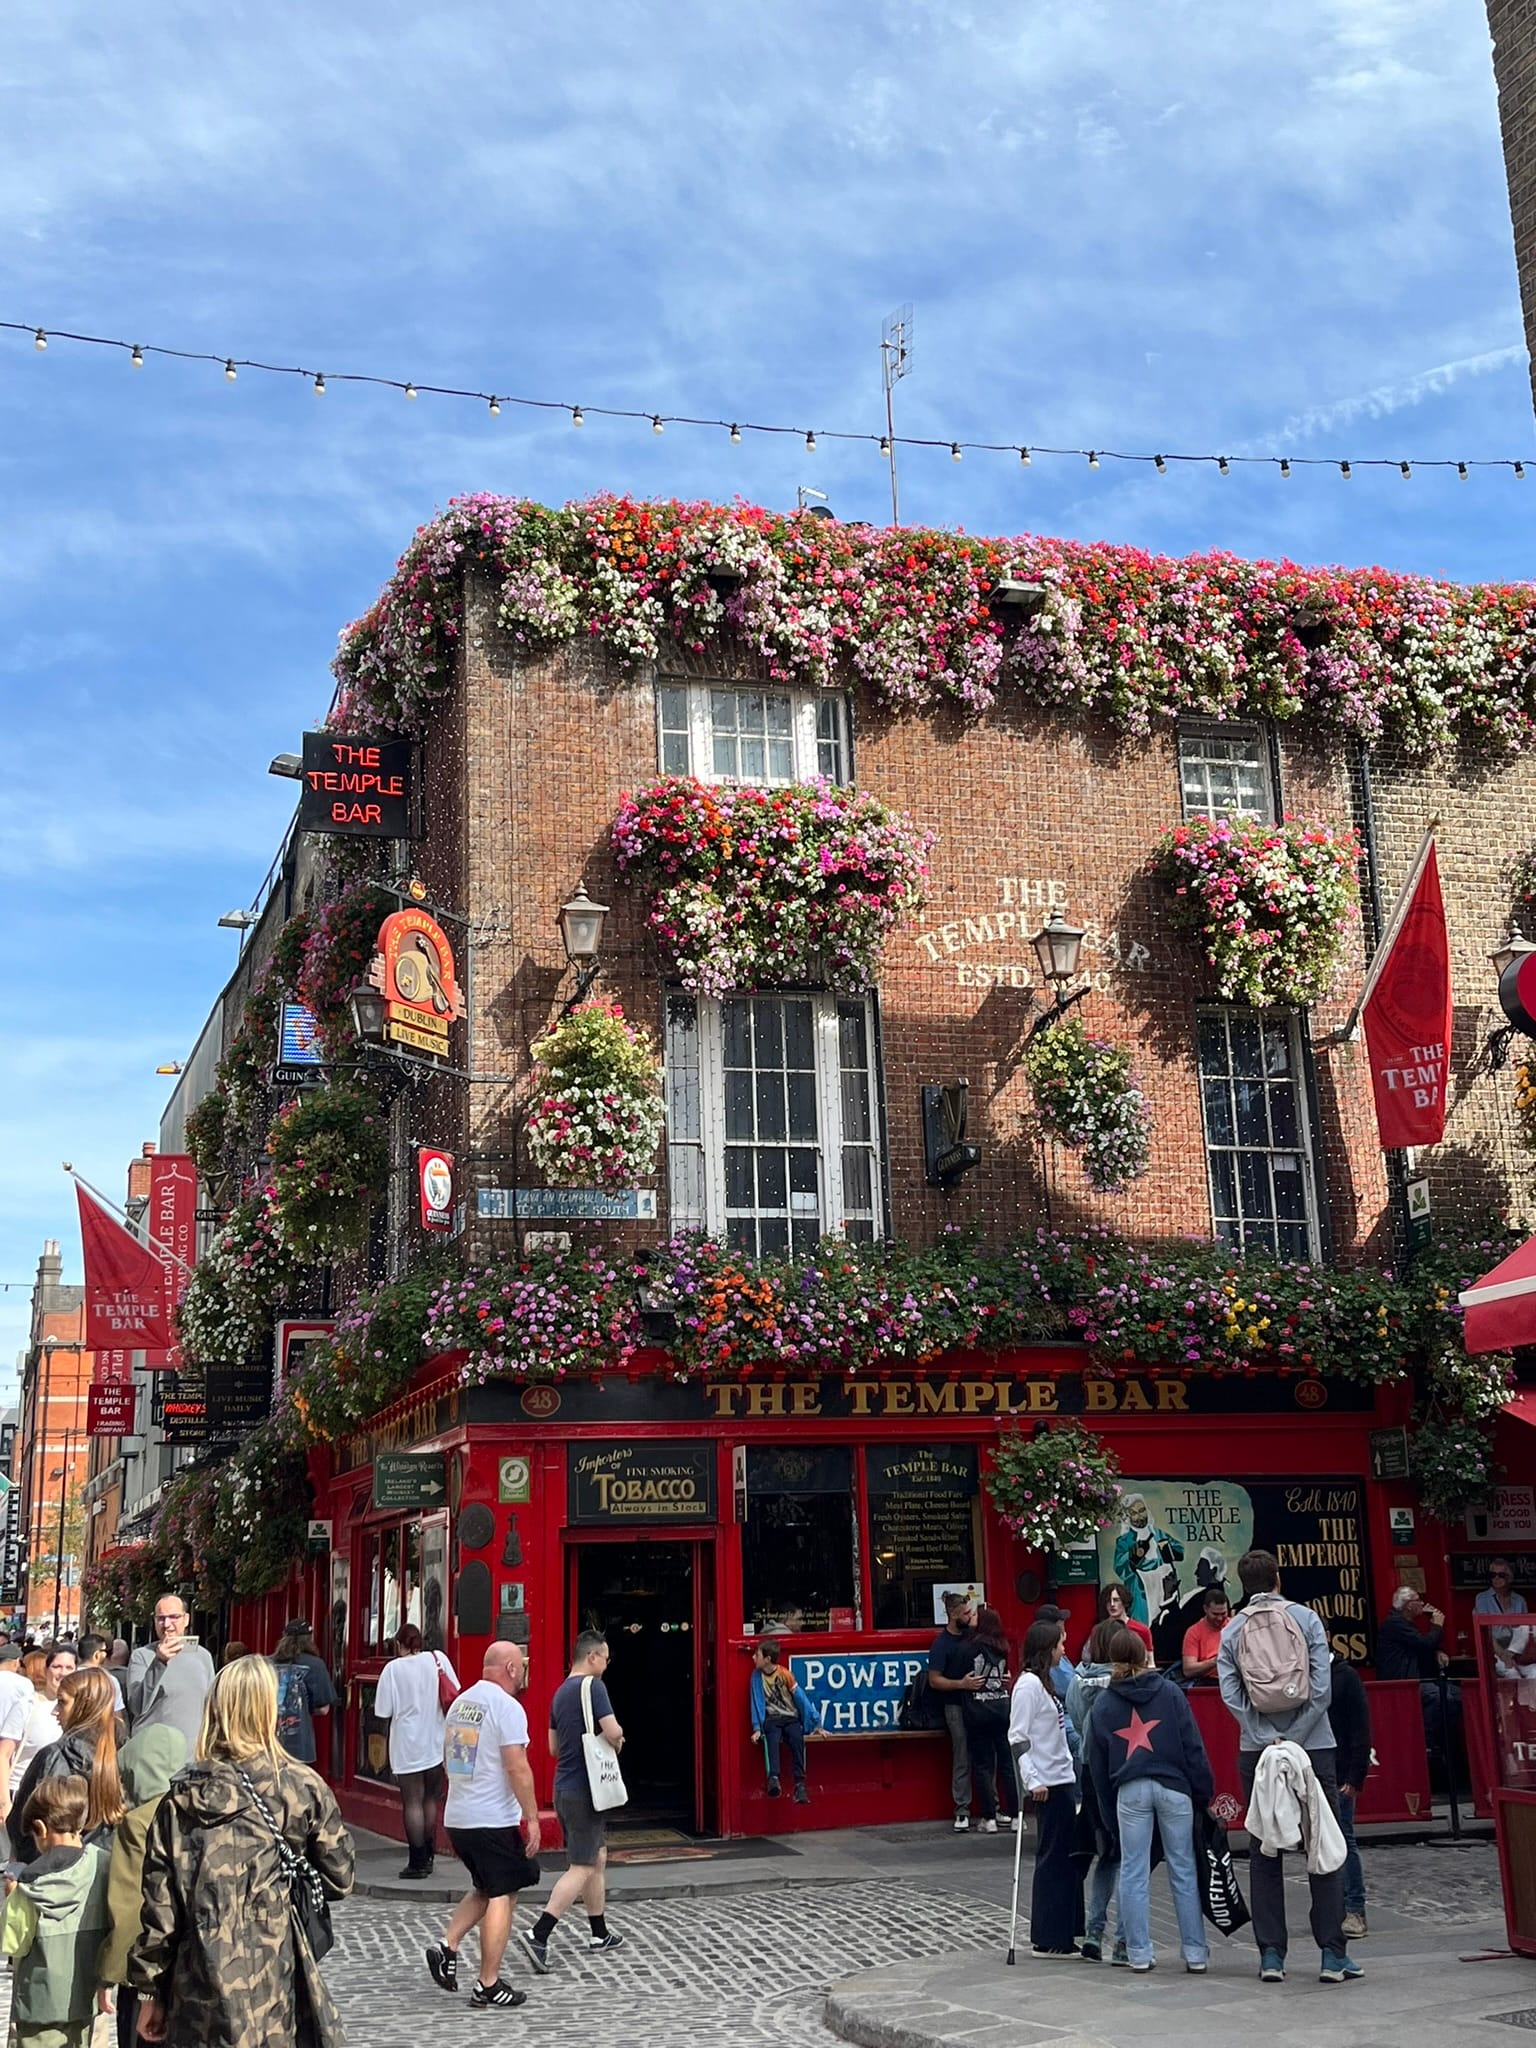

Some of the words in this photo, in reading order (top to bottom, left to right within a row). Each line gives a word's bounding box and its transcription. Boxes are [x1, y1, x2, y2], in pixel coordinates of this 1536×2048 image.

[332, 744, 381, 767] THE
[307, 771, 404, 796] TEMPLE
[332, 802, 382, 824] BAR
[996, 878, 1068, 907] THE
[399, 916, 441, 941] TEMPLE
[1082, 919, 1151, 972] BAR
[403, 1008, 438, 1028] DUBLIN
[396, 1027, 416, 1043] LIVE
[417, 1034, 444, 1051] MUSIC
[1409, 1043, 1444, 1062] THE
[161, 1184, 175, 1221] BAR
[592, 1204, 631, 1215] SOUTH
[178, 1222, 189, 1241] CO.
[112, 1293, 139, 1304] THE
[92, 1304, 160, 1318] TEMPLE
[111, 1317, 147, 1330] BAR
[93, 1397, 131, 1405] TEMPLE
[104, 1387, 122, 1396] THE
[179, 1392, 205, 1400] TEMPL
[528, 1390, 552, 1409] 48
[706, 1383, 822, 1415] THE
[844, 1381, 1058, 1415] TEMPLE
[1084, 1379, 1190, 1411] BAR
[1299, 1384, 1320, 1402] 48
[100, 1407, 121, 1415] BAR
[413, 1400, 437, 1441] BAR
[574, 1447, 633, 1473] Importers
[917, 1450, 933, 1459] The
[626, 1467, 647, 1476] FINE
[650, 1466, 694, 1476] SMOKING
[883, 1461, 939, 1478] TEMPLE
[941, 1462, 968, 1478] BAR
[590, 1473, 696, 1511] TOBACCO
[1183, 1489, 1223, 1507] THE
[1327, 1490, 1357, 1512] 1840
[611, 1503, 652, 1513] Always
[657, 1503, 668, 1512] in
[672, 1502, 705, 1511] Stock
[1165, 1507, 1241, 1525] TEMPLE
[1502, 1508, 1530, 1518] GOOD
[1186, 1525, 1225, 1543] BAR
[1318, 1518, 1358, 1541] THE
[1492, 1520, 1511, 1529] FOR
[1514, 1520, 1532, 1529] YOU
[1276, 1542, 1360, 1567] EMPEROR
[1340, 1568, 1360, 1591] OF
